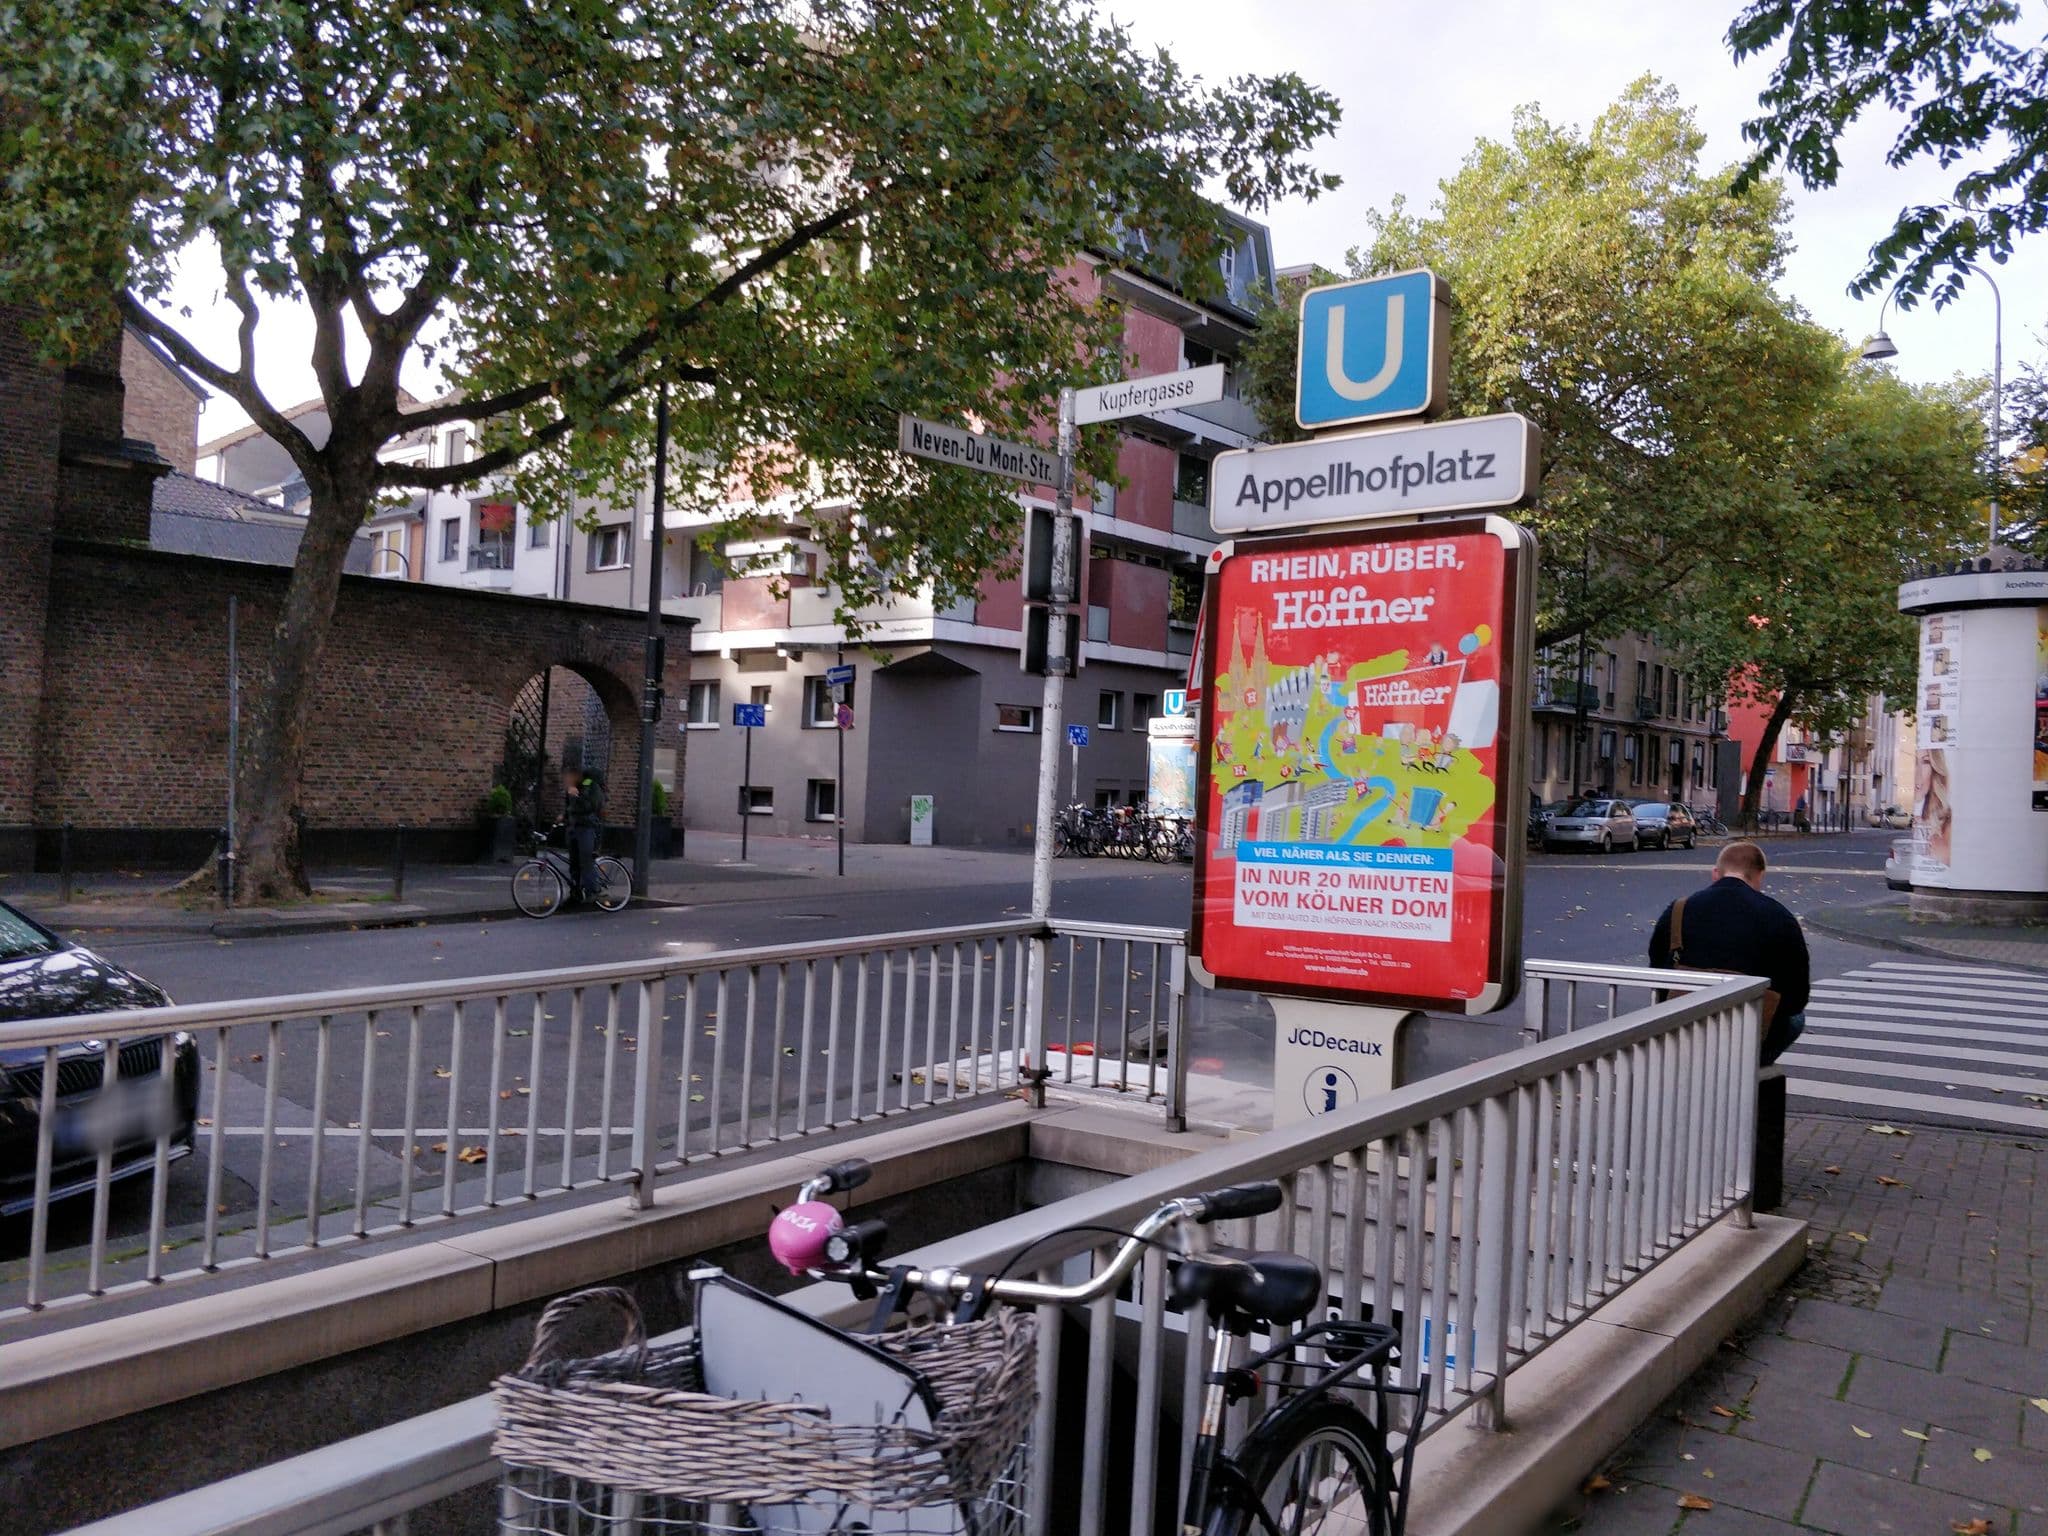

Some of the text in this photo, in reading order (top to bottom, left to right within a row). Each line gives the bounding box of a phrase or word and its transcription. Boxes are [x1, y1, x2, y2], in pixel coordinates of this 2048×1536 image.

[1326, 294, 1404, 401] U
[1099, 380, 1194, 413] Kupfergasse
[912, 422, 1052, 481] Neven-Du Mont-Str.
[1235, 449, 1496, 513] Appellhofplatz
[1251, 543, 1464, 583] RHEIN, RÜBER,
[1271, 585, 1435, 630] Höffner
[1169, 692, 1184, 714] U
[1364, 680, 1452, 706] Höffner
[1254, 846, 1434, 865] VIEL NÄHER ALS SIE DENKEN:
[1242, 867, 1448, 894] IN NUR 20 MINUTEN
[1241, 888, 1447, 919] VOM KÖLNER DOM
[1287, 1027, 1383, 1056] JCDecaux
